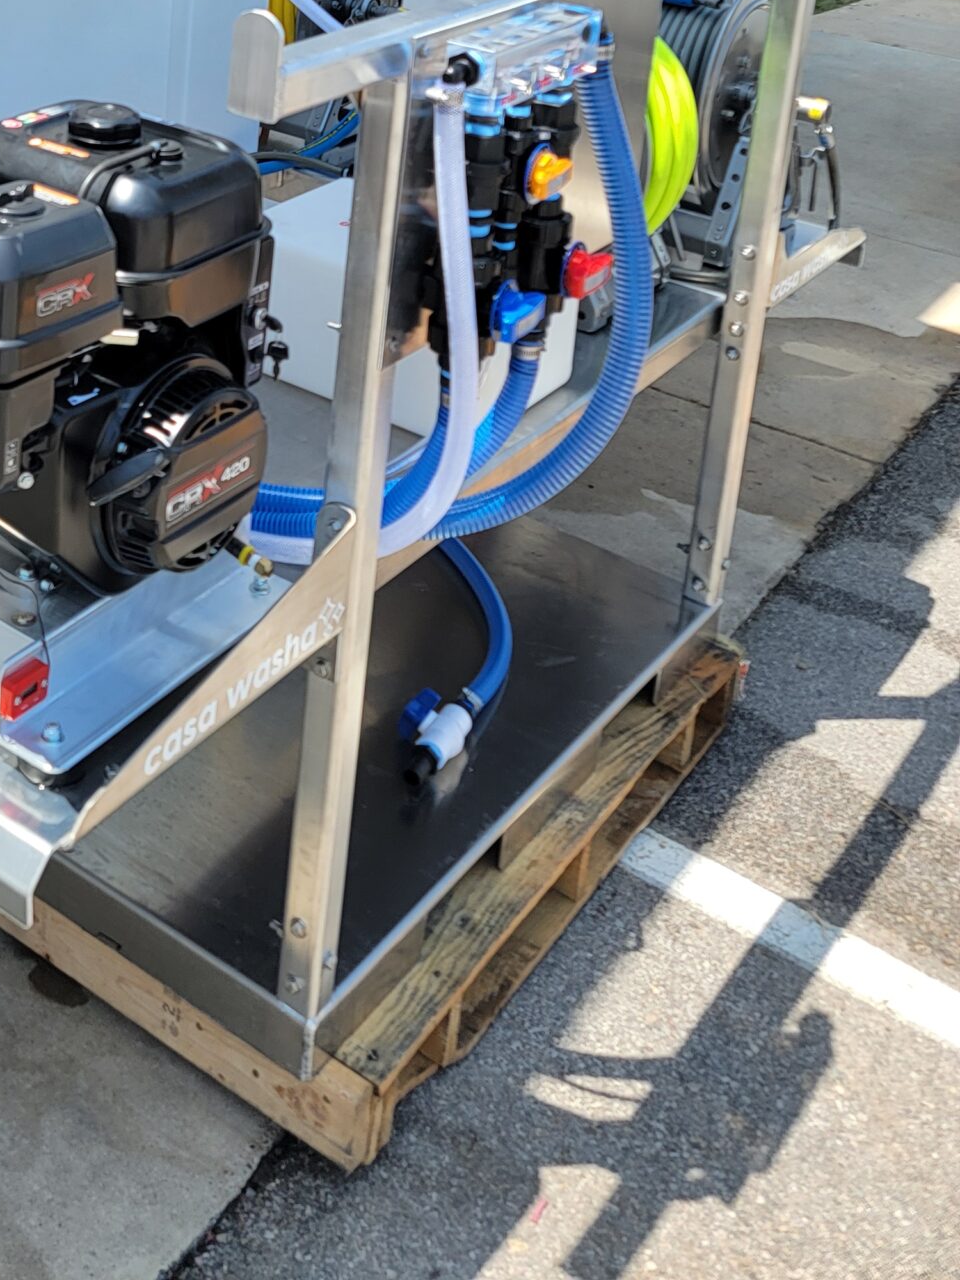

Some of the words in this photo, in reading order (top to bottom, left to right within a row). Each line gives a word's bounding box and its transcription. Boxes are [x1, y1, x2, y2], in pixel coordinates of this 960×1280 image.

[36, 272, 96, 318] CRX
[165, 463, 224, 522] CRX
[220, 456, 251, 482] 420
[144, 699, 218, 776] casa
[226, 622, 319, 710] washa
